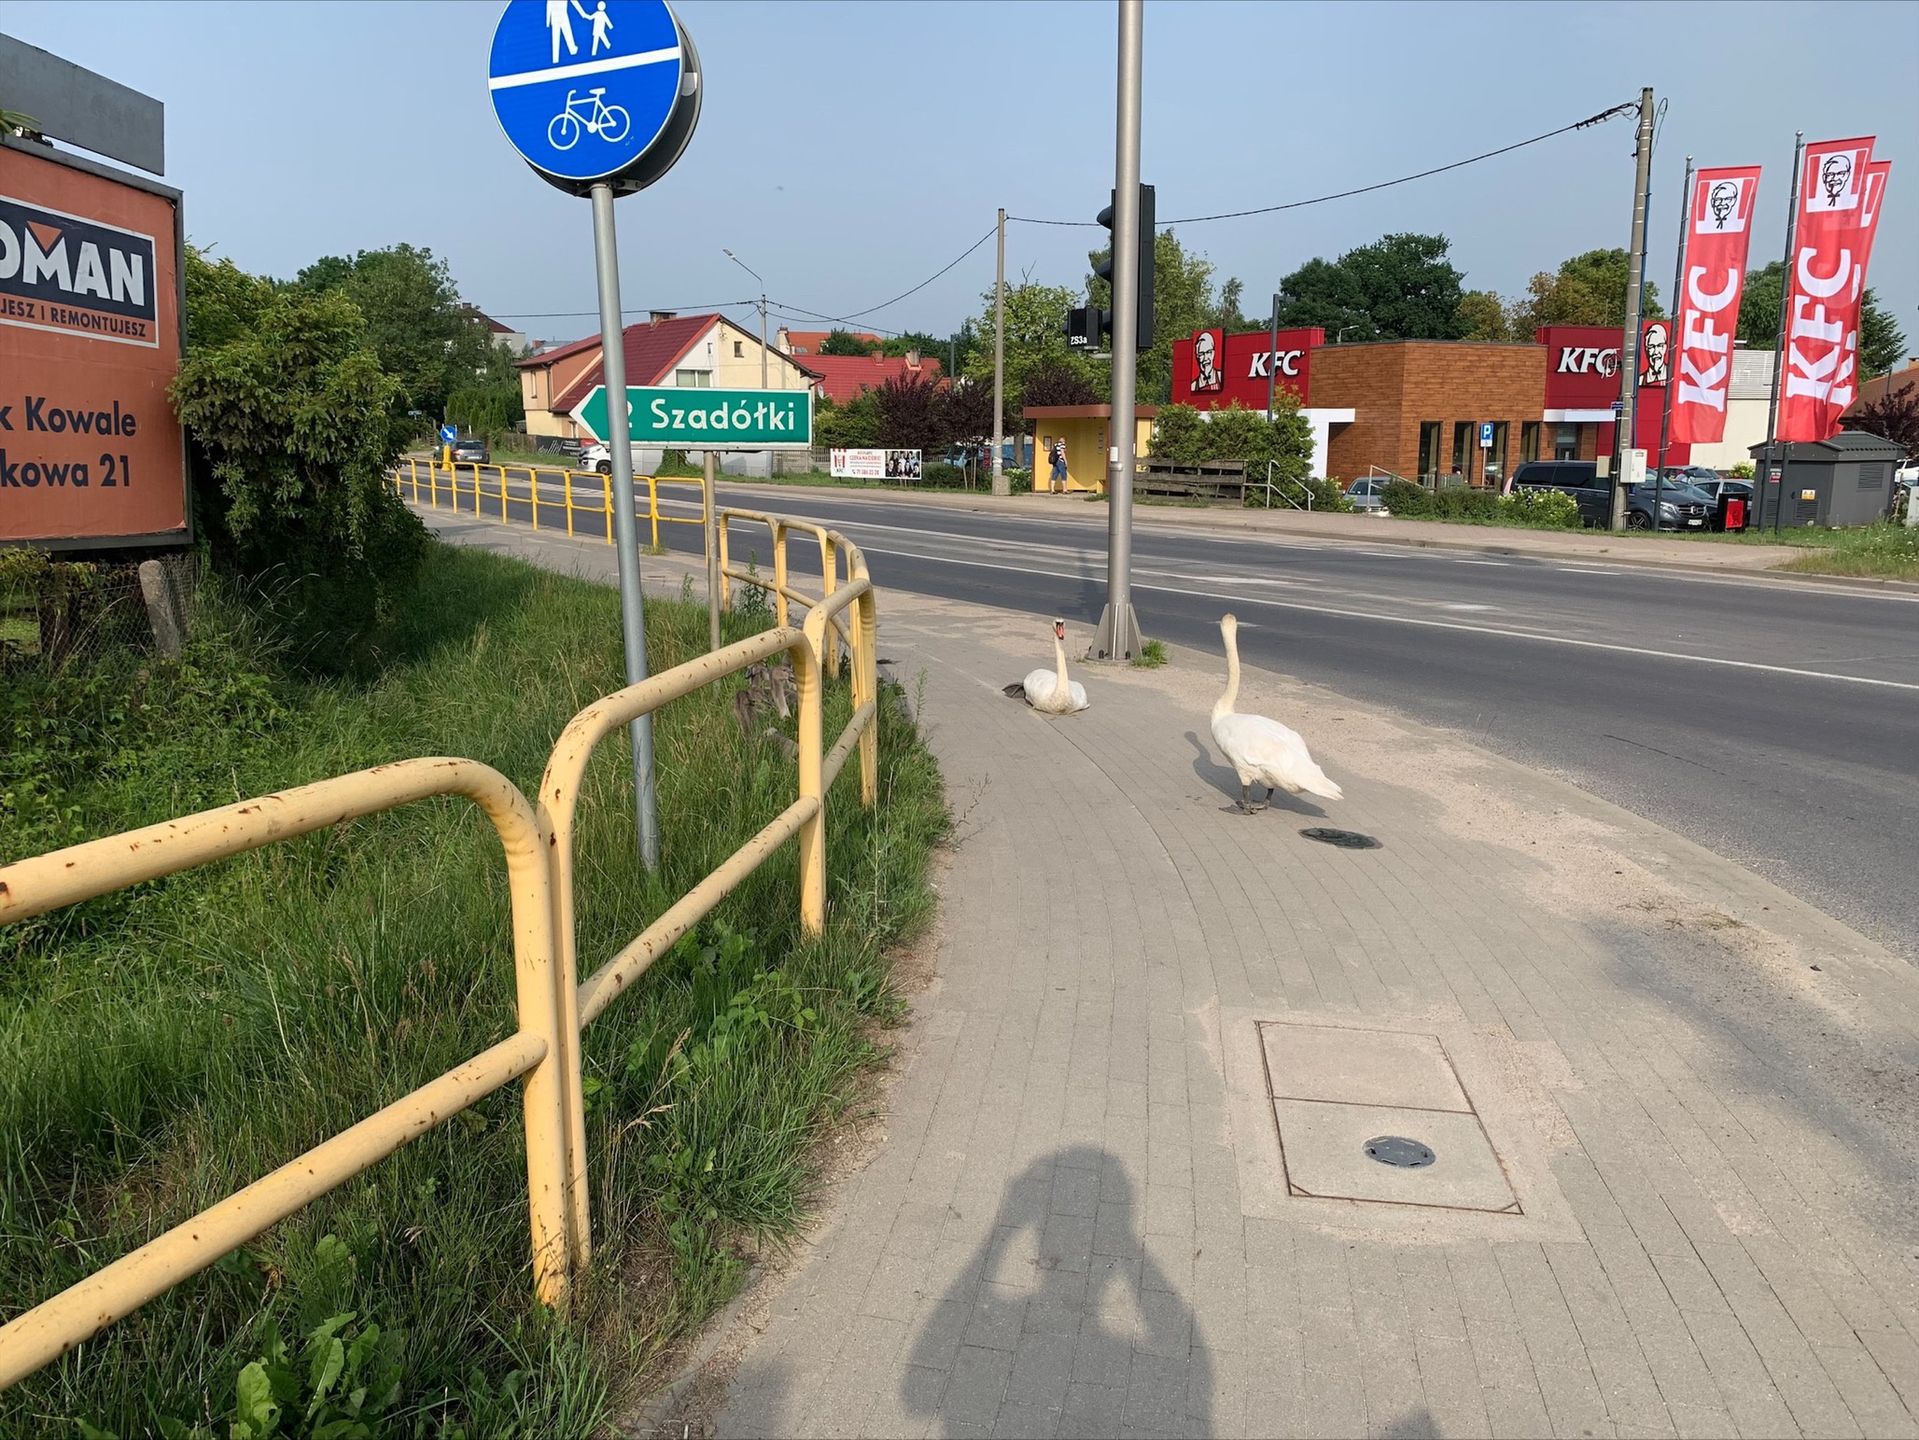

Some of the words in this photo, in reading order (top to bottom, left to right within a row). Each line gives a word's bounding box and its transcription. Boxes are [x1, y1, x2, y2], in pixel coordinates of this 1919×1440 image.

[41, 305, 45, 320] I
[50, 307, 146, 337] REMONTUJESZ
[1786, 247, 1851, 405] KFC
[1678, 265, 1738, 412] KFC
[1248, 350, 1301, 377] KFC
[1557, 347, 1618, 374] KFC
[25, 396, 136, 437] Kowale
[650, 398, 794, 430] Szadółki
[1484, 424, 1491, 438] P
[0, 448, 88, 487] kowa
[99, 453, 130, 487] 21
